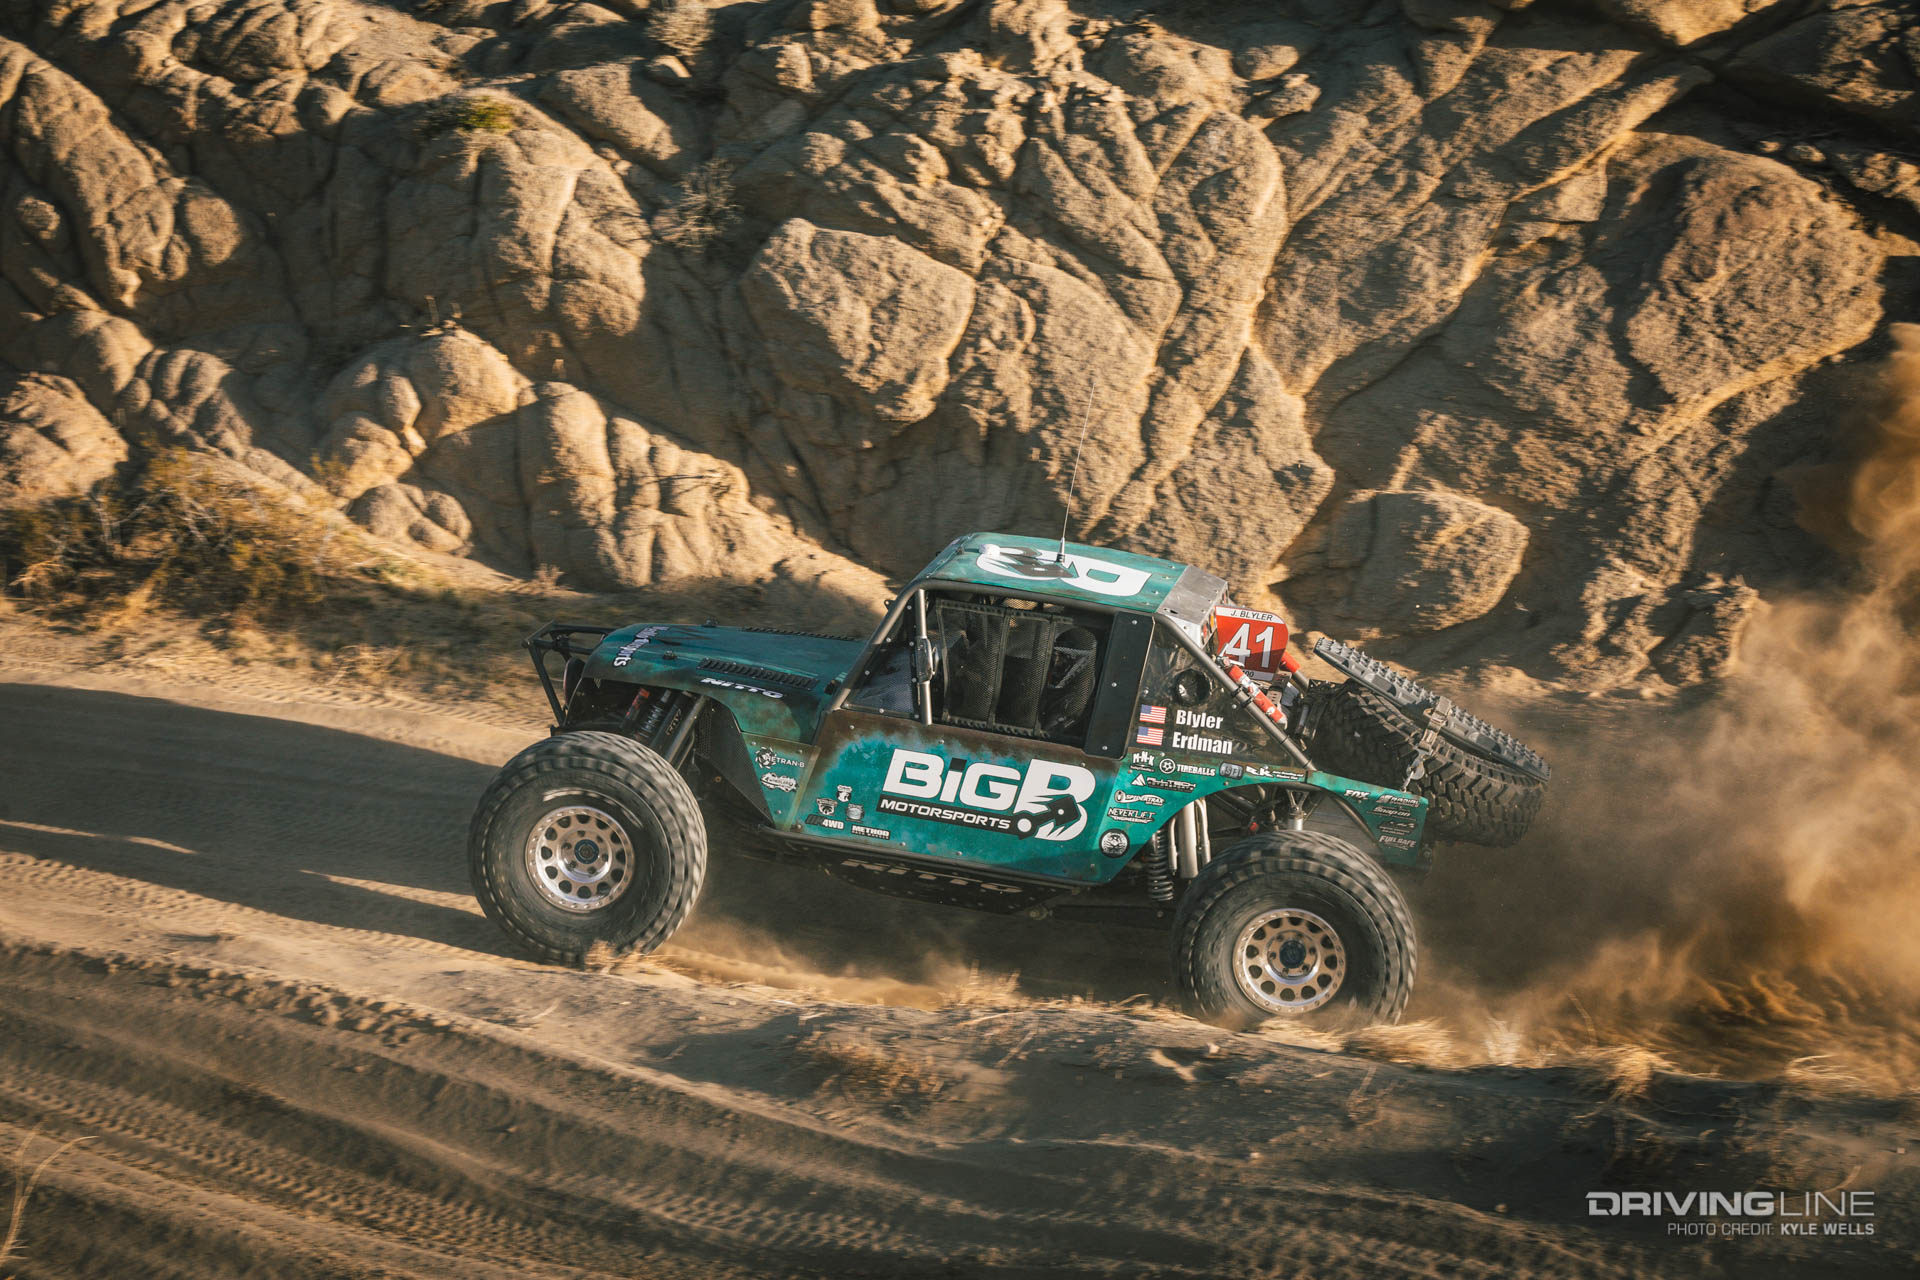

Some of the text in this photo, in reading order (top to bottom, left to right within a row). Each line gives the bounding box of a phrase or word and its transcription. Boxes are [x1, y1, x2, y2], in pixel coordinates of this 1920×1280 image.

[1240, 611, 1273, 621] BLYLER
[1225, 622, 1274, 669] 41
[700, 677, 783, 698] NITTO
[1175, 709, 1224, 730] Blyler
[1172, 731, 1233, 755] Erdman
[1176, 764, 1216, 777] TIREBALLS
[880, 799, 1012, 830] MOTORSPORTS
[852, 825, 890, 837] METHOD
